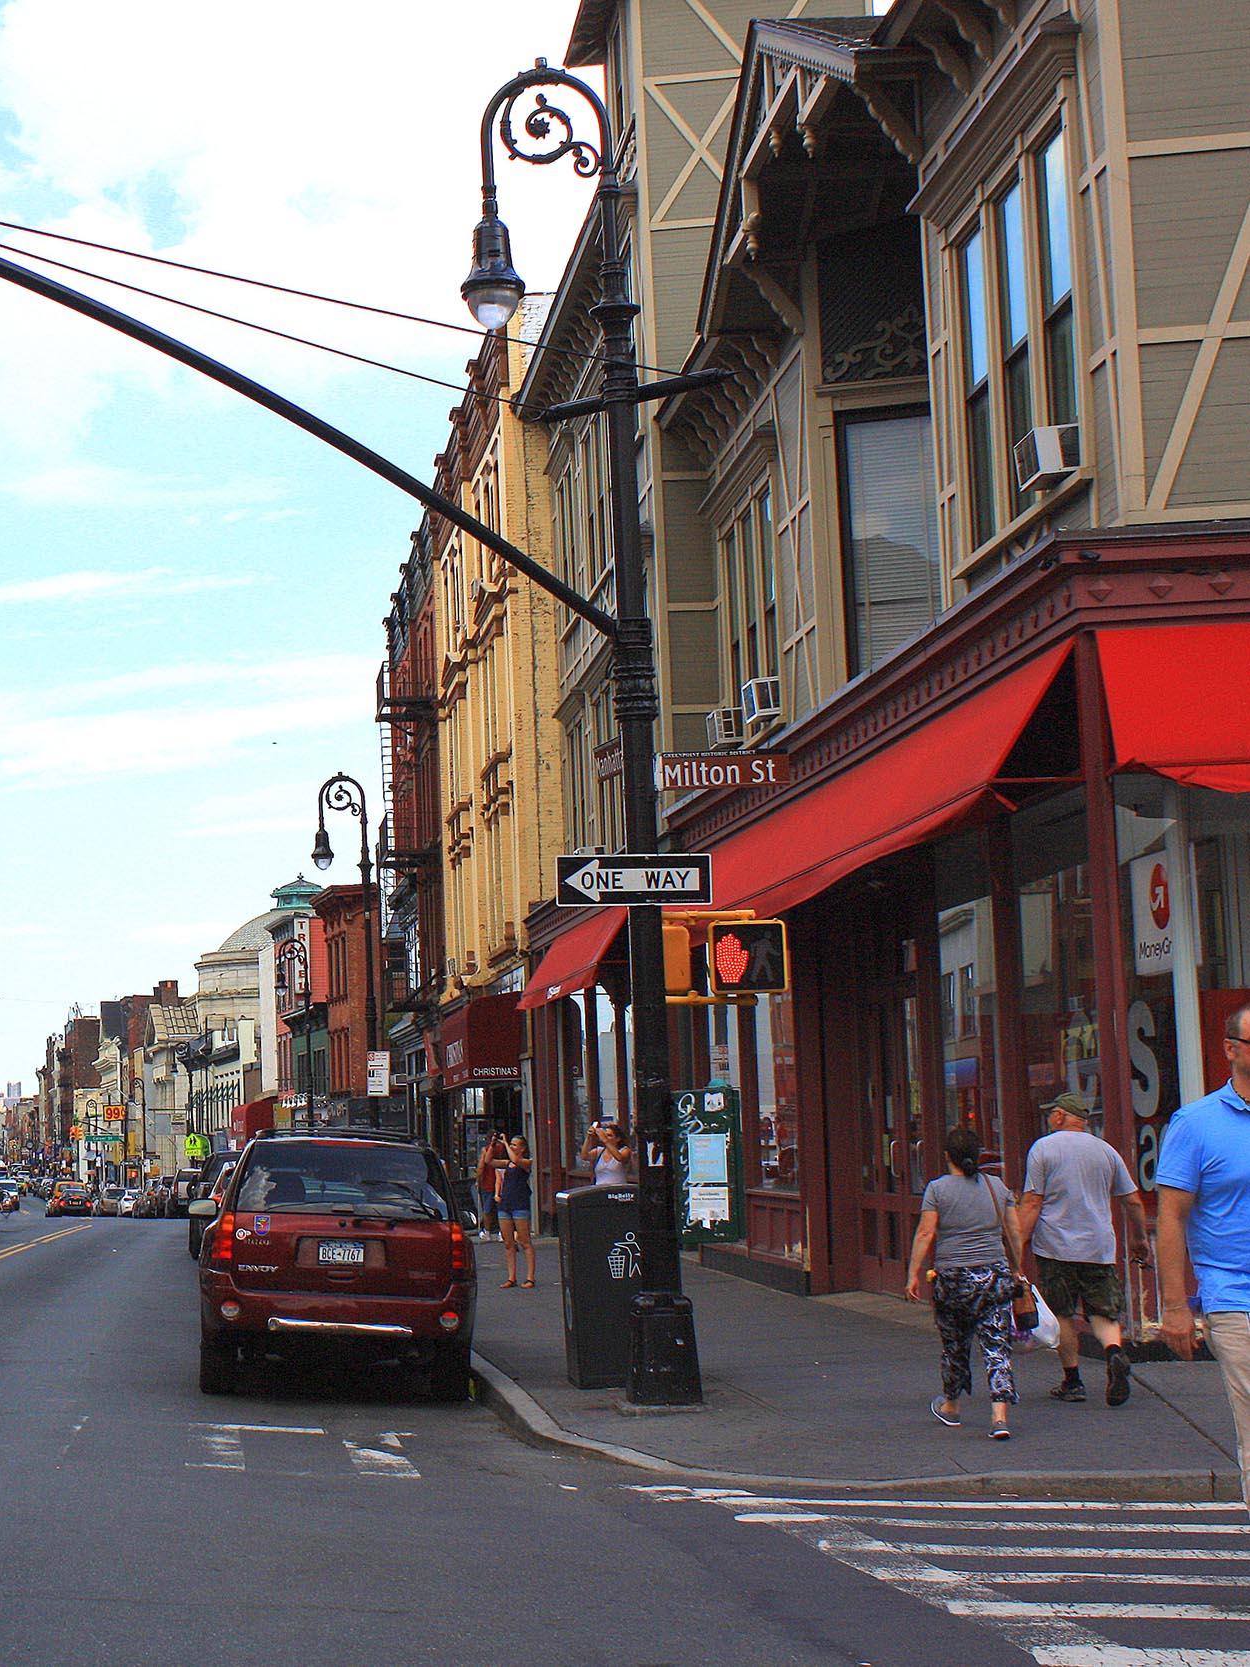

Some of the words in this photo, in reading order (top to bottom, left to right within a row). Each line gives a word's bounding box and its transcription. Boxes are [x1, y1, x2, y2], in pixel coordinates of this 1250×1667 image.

[664, 761, 740, 787] Milton
[751, 759, 776, 783] St
[581, 871, 623, 890] ONE
[644, 870, 690, 889] WAY
[472, 1066, 518, 1077] CHRISTINA'S
[237, 1264, 279, 1272] ENVOY
